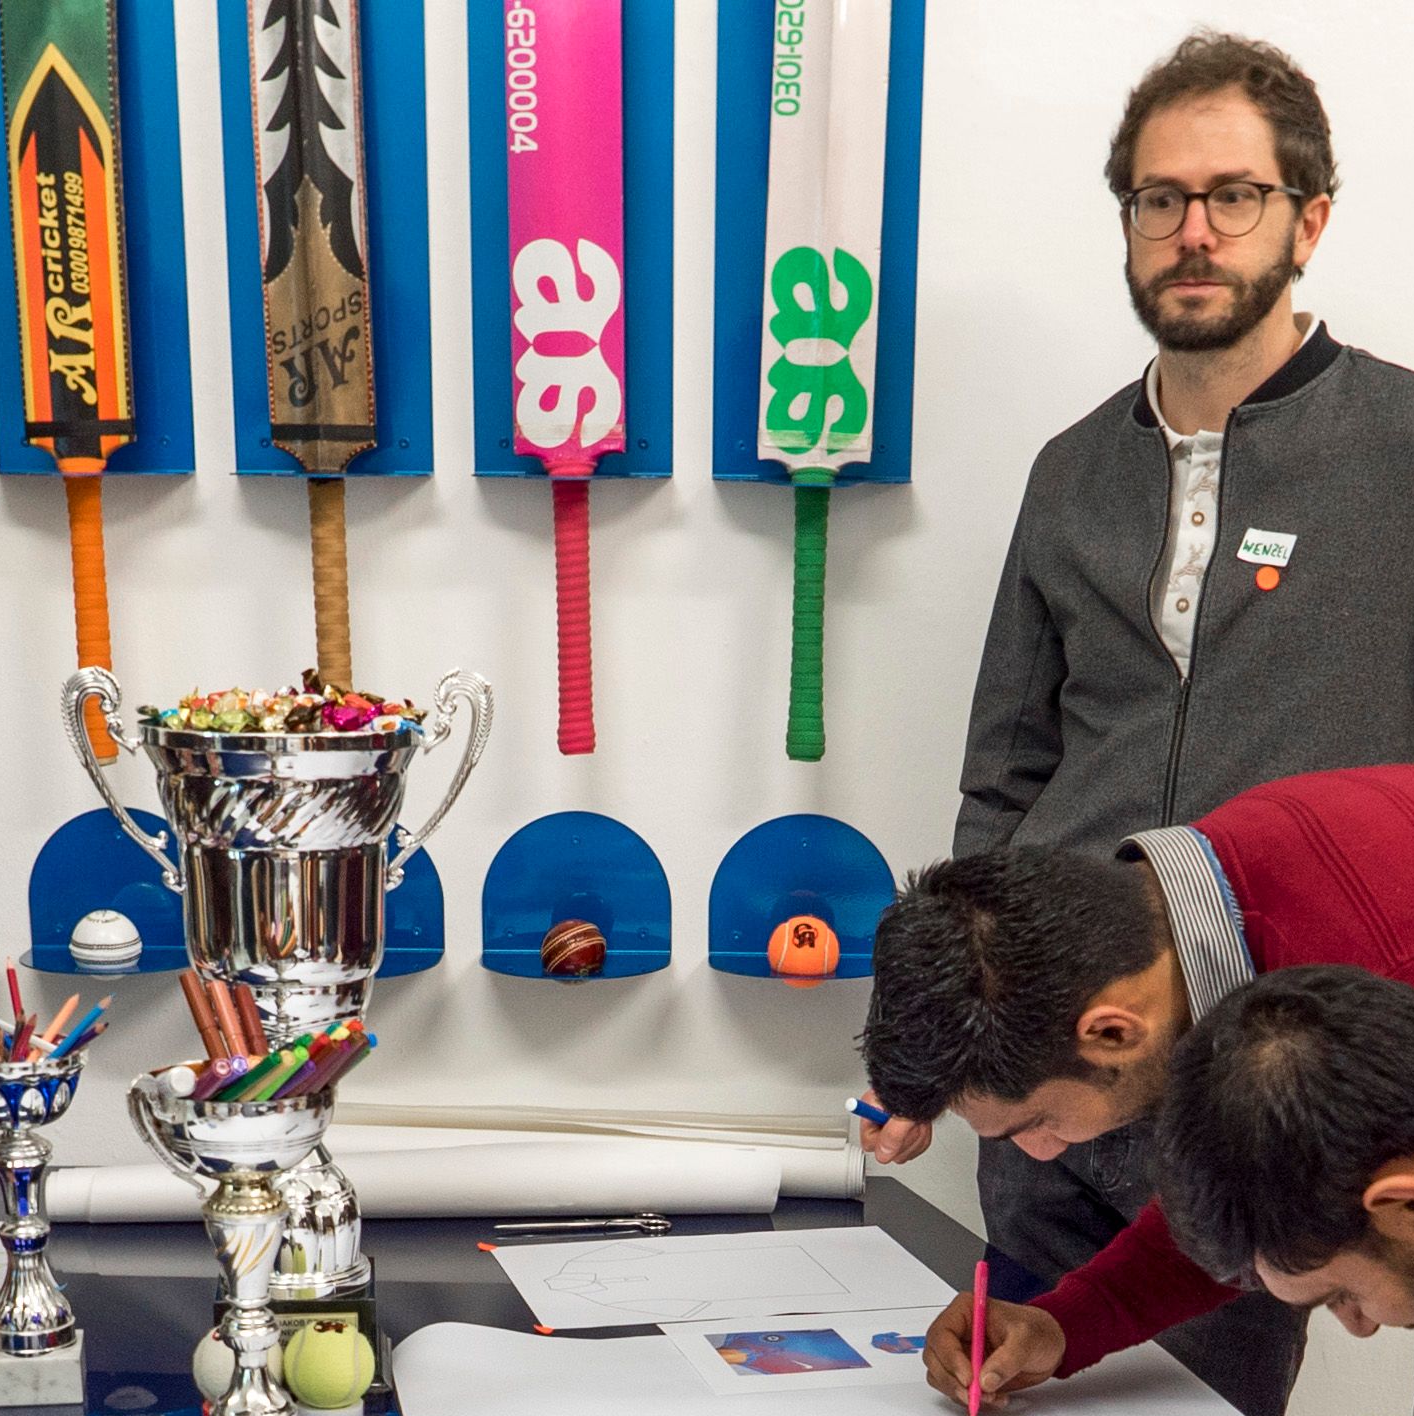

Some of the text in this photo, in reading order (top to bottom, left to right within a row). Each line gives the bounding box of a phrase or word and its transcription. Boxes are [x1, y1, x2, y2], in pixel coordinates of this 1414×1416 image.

[63, 170, 91, 295] 0300 9871499
[35, 171, 98, 405] AR cricket
[272, 290, 362, 354] SPORTS
[279, 325, 361, 408] AR
